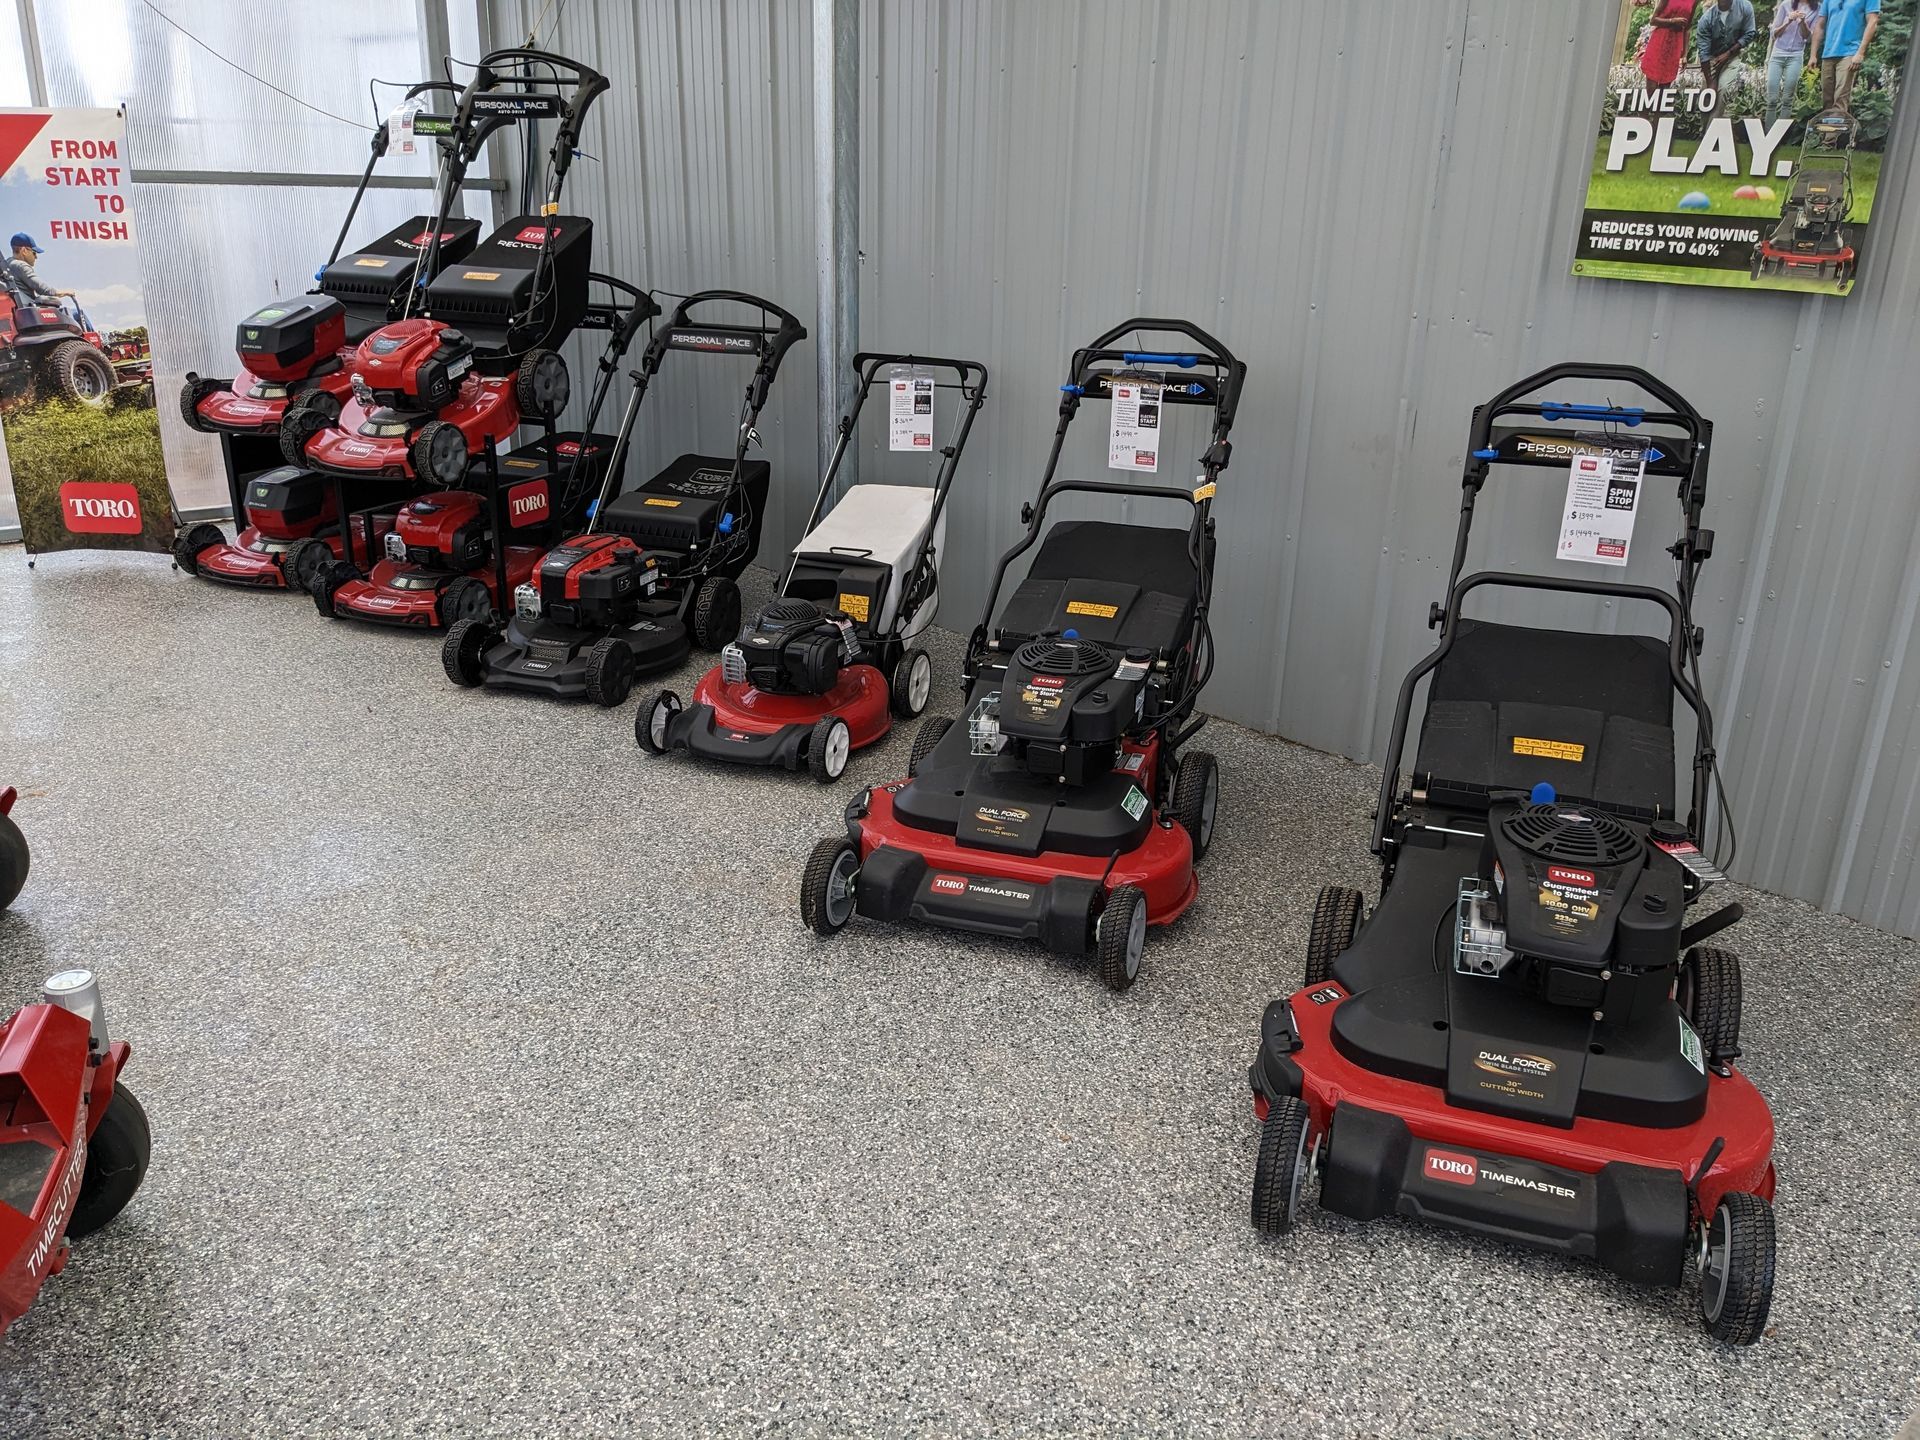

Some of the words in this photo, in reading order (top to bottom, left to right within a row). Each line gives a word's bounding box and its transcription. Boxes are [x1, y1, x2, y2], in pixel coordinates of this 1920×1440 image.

[474, 101, 521, 109] PERSONAL
[523, 101, 549, 109] PACE
[1615, 88, 1677, 112] TIME
[1685, 88, 1717, 112] TO
[435, 122, 451, 130] PAC
[50, 140, 118, 159] FROM
[1605, 117, 1794, 177] PLAY.
[45, 167, 121, 186] START
[94, 194, 125, 213] TO
[50, 221, 129, 240] FINISH
[1590, 220, 1654, 237] REDUCES
[1657, 224, 1694, 239] YOUR
[1697, 227, 1760, 243] MOWING
[497, 239, 543, 250] RECYCL
[1589, 236, 1622, 250] TIME
[1624, 238, 1644, 251] BY
[1645, 239, 1666, 253] UP
[1667, 241, 1686, 254] TO
[671, 334, 722, 345] PERSONAL
[725, 338, 751, 347] PACE
[1161, 384, 1188, 393] PACE
[1517, 443, 1595, 456] PERSONAL
[1602, 448, 1641, 459] PACE
[695, 472, 732, 481] TORO
[1607, 496, 1633, 506] STOP
[1609, 487, 1633, 498] SPIN
[69, 498, 136, 519] TORO
[512, 493, 547, 515] TORO
[1026, 684, 1064, 693] Guaranteed
[979, 806, 1000, 815] DUAL
[1000, 810, 1026, 820] FORCE
[976, 827, 1001, 835] CUTTING
[1551, 869, 1593, 882] TORO
[935, 879, 964, 890] TORO
[968, 884, 1031, 900] TIMEMASTER
[1542, 880, 1599, 897] Guaranteed
[1553, 889, 1562, 897] to
[1571, 905, 1590, 913] OHV
[1554, 913, 1578, 924] 223cc
[1478, 1051, 1510, 1064] DUAL
[1512, 1057, 1553, 1072] FORCE
[1482, 1060, 1500, 1068] TWIN
[1500, 1063, 1522, 1072] BLADE
[1523, 1067, 1547, 1077] SYSTEM
[1480, 1081, 1516, 1093] CUTTING
[1517, 1088, 1544, 1099] WIDTH
[1428, 1157, 1474, 1176] TORO
[1480, 1169, 1576, 1199] TIMEMASTER
[27, 1138, 84, 1278] TIMECUTTER
